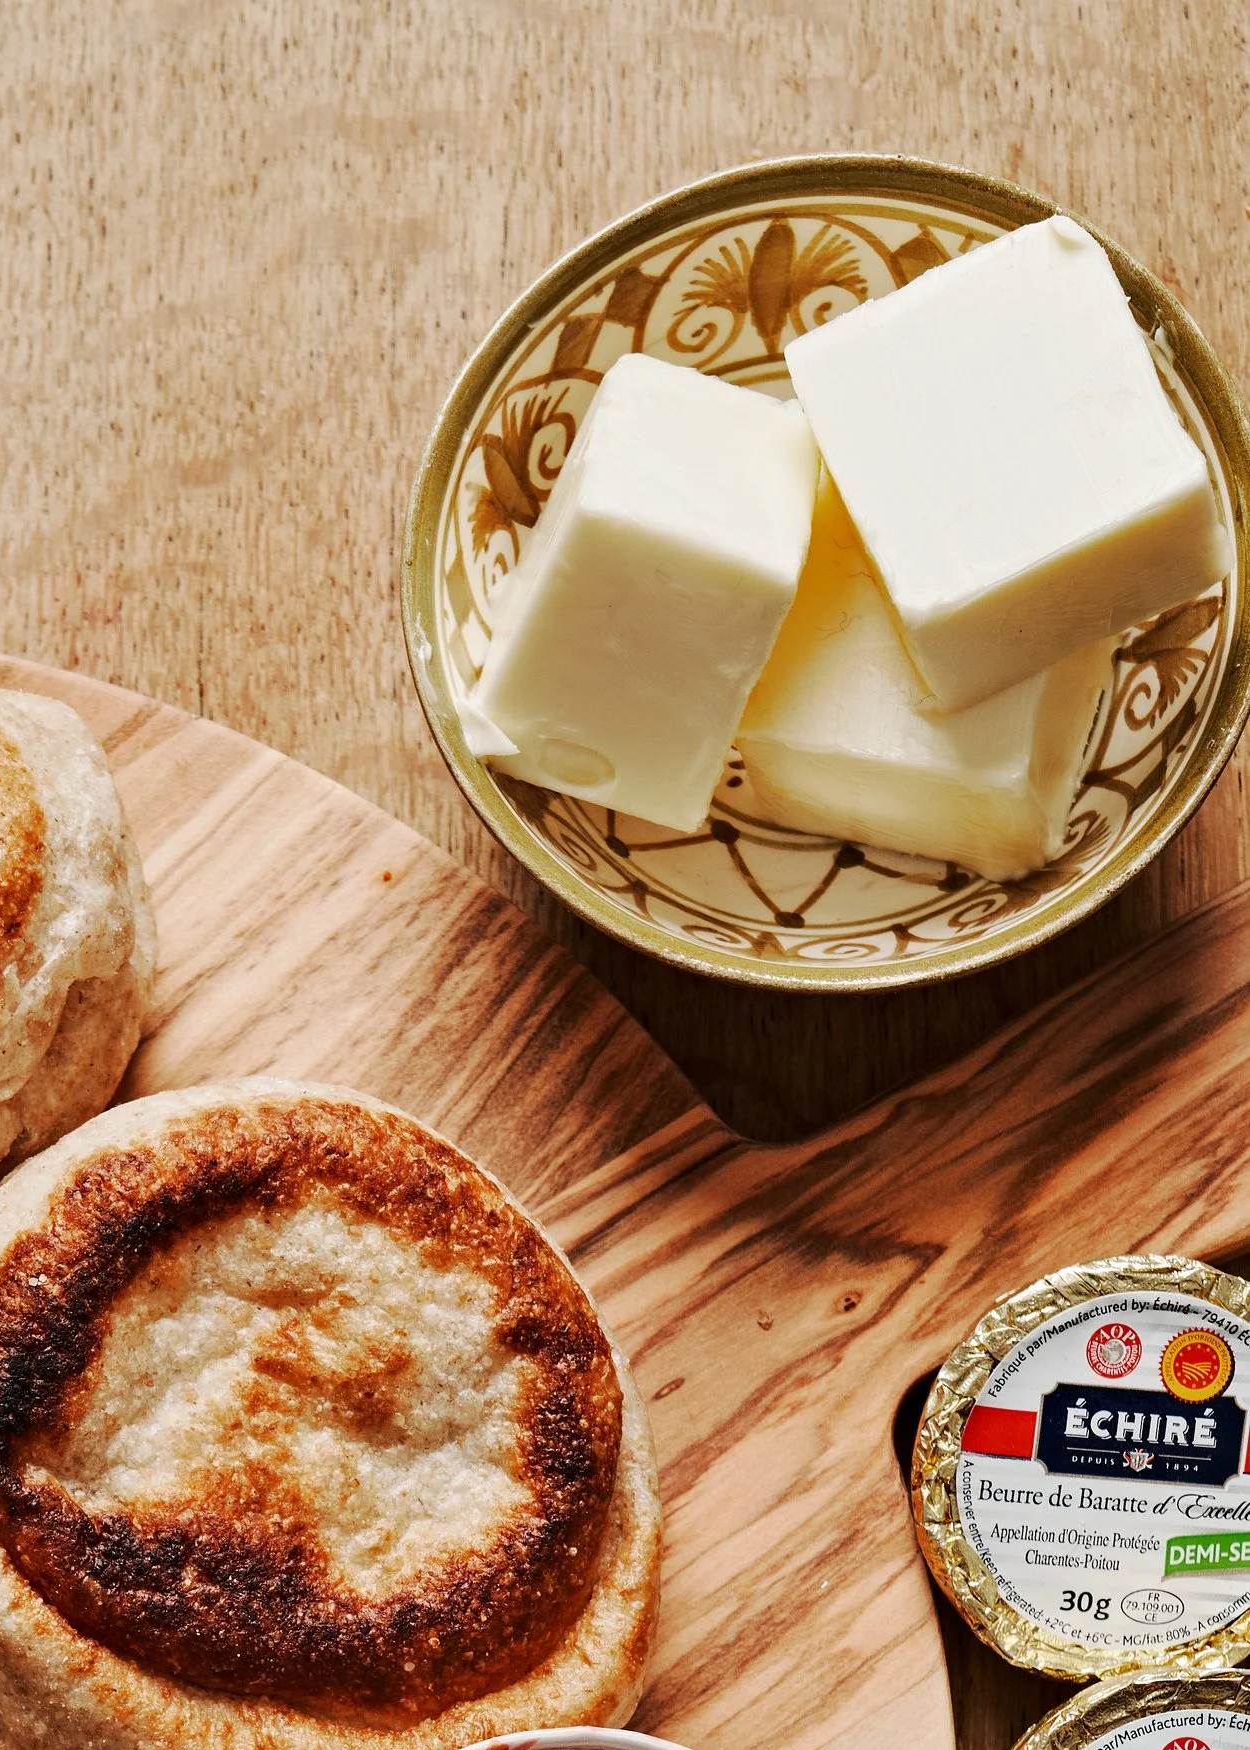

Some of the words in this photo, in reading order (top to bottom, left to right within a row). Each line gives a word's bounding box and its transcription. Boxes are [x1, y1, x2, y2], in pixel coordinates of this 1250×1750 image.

[1099, 1325, 1136, 1342] AOP
[988, 1351, 1027, 1397] Fabriqué
[1026, 1299, 1128, 1356] par/Manufactured
[1131, 1299, 1150, 1313] by:
[1153, 1297, 1191, 1314] Échiré
[1201, 1310, 1239, 1335] 79410
[1064, 1398, 1217, 1448] ÉCHIRÉ
[963, 1460, 974, 1469] A
[1071, 1456, 1115, 1465] DEPUIS
[1165, 1462, 1199, 1471] 1894
[962, 1472, 976, 1520] conserver
[978, 1480, 1044, 1505] Beurre
[1049, 1485, 1073, 1507] de
[1078, 1488, 1148, 1513] Baratte
[990, 1523, 1055, 1543] Appellation
[1058, 1529, 1109, 1549] d'Origine
[1112, 1533, 1161, 1553] Protégée
[968, 1523, 998, 1575] entre/Keep
[1170, 1541, 1250, 1566] DEMI-SE
[1025, 1549, 1120, 1571] Charentes-Poitou
[995, 1574, 1044, 1621] refrigerated:
[1148, 1592, 1160, 1601] FR
[1125, 1601, 1180, 1613] 79.109.001
[1207, 1591, 1250, 1626] consomm
[1144, 1613, 1157, 1622] CE
[1071, 1628, 1083, 1639] et
[1122, 1633, 1164, 1646] MG/fat:
[1165, 1626, 1191, 1641] 80%
[1208, 1713, 1227, 1729] by:
[1229, 1714, 1250, 1732] Éch
